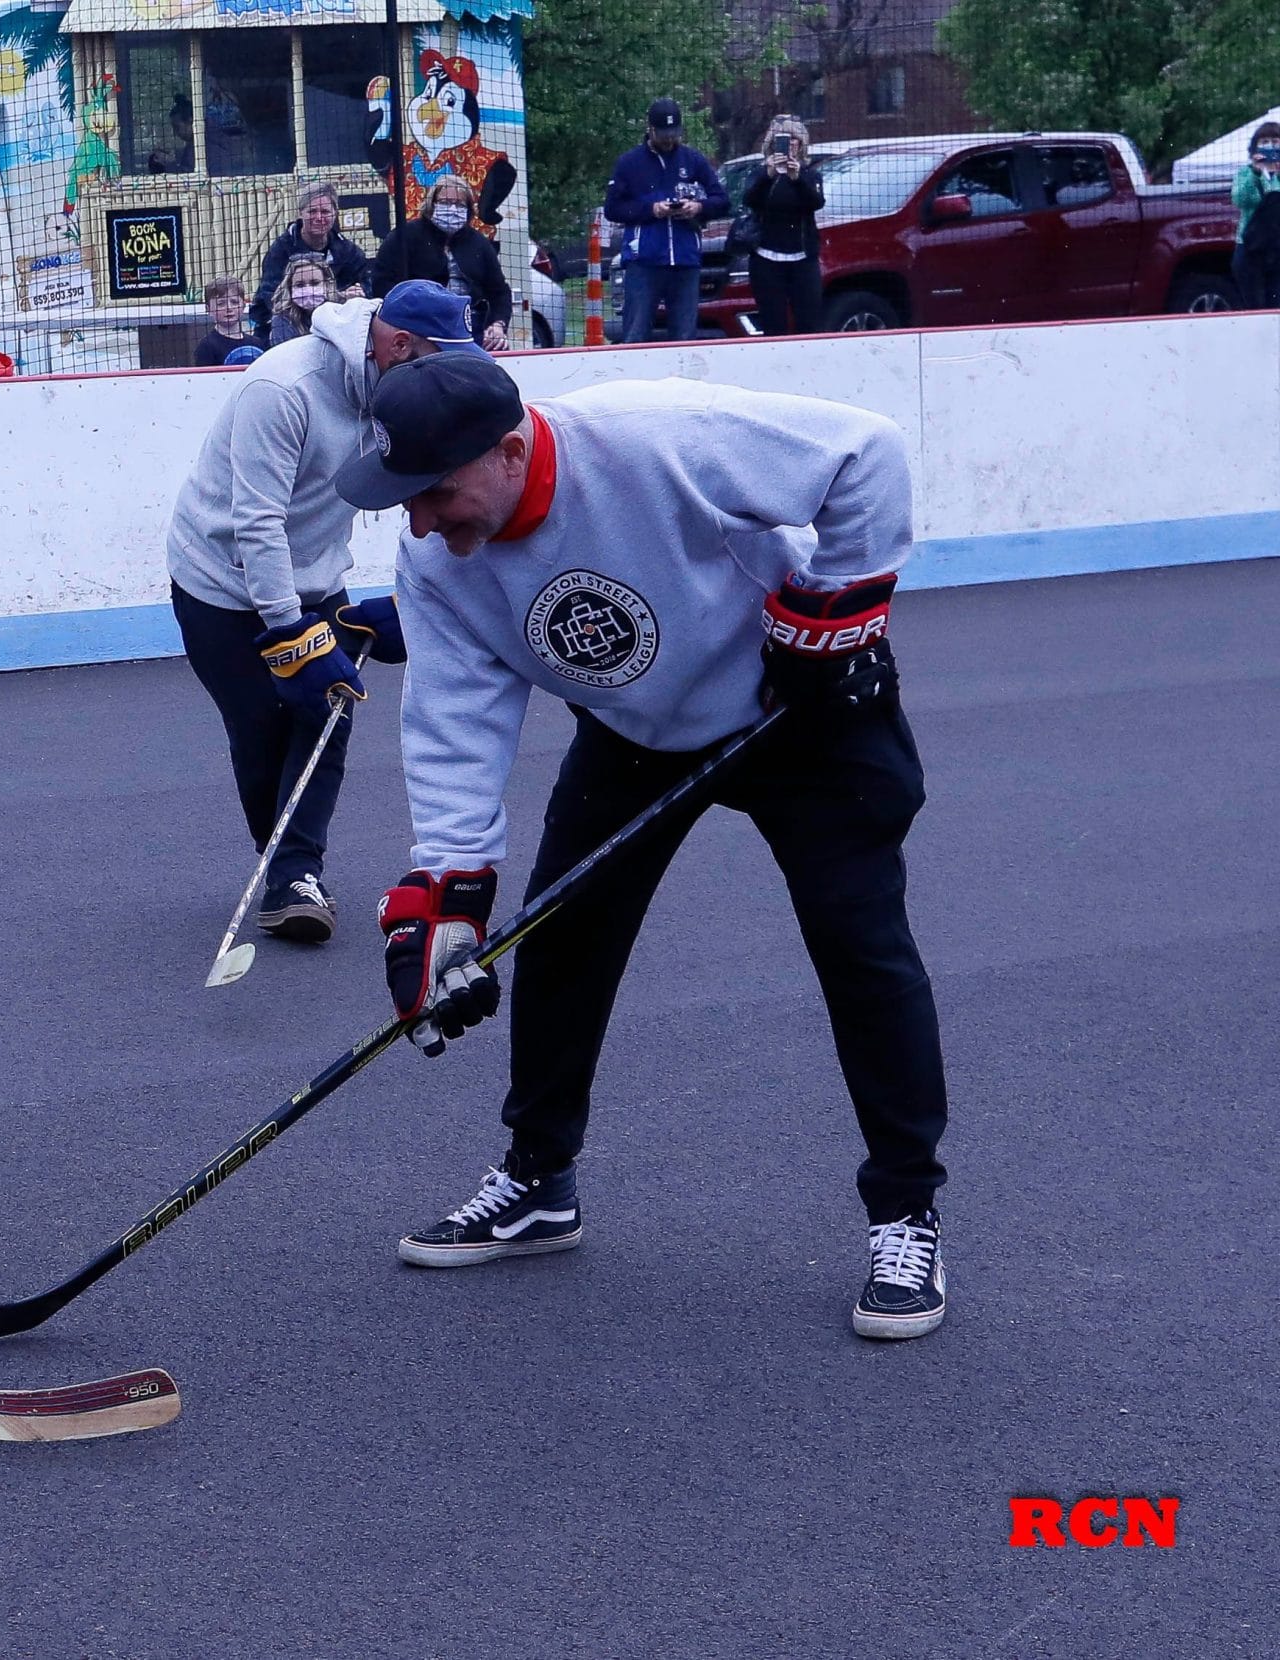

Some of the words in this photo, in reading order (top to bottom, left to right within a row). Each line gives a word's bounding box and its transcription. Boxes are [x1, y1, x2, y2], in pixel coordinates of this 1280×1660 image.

[129, 222, 156, 237] BOOK
[343, 212, 365, 227] 62
[122, 231, 171, 257] KONA
[530, 575, 582, 646] COVINGTON
[586, 576, 639, 609] STREET
[761, 608, 887, 652] BAUER
[554, 664, 614, 685] HOCKEY
[623, 631, 655, 679] LEAGUE
[129, 1382, 159, 1398] 950
